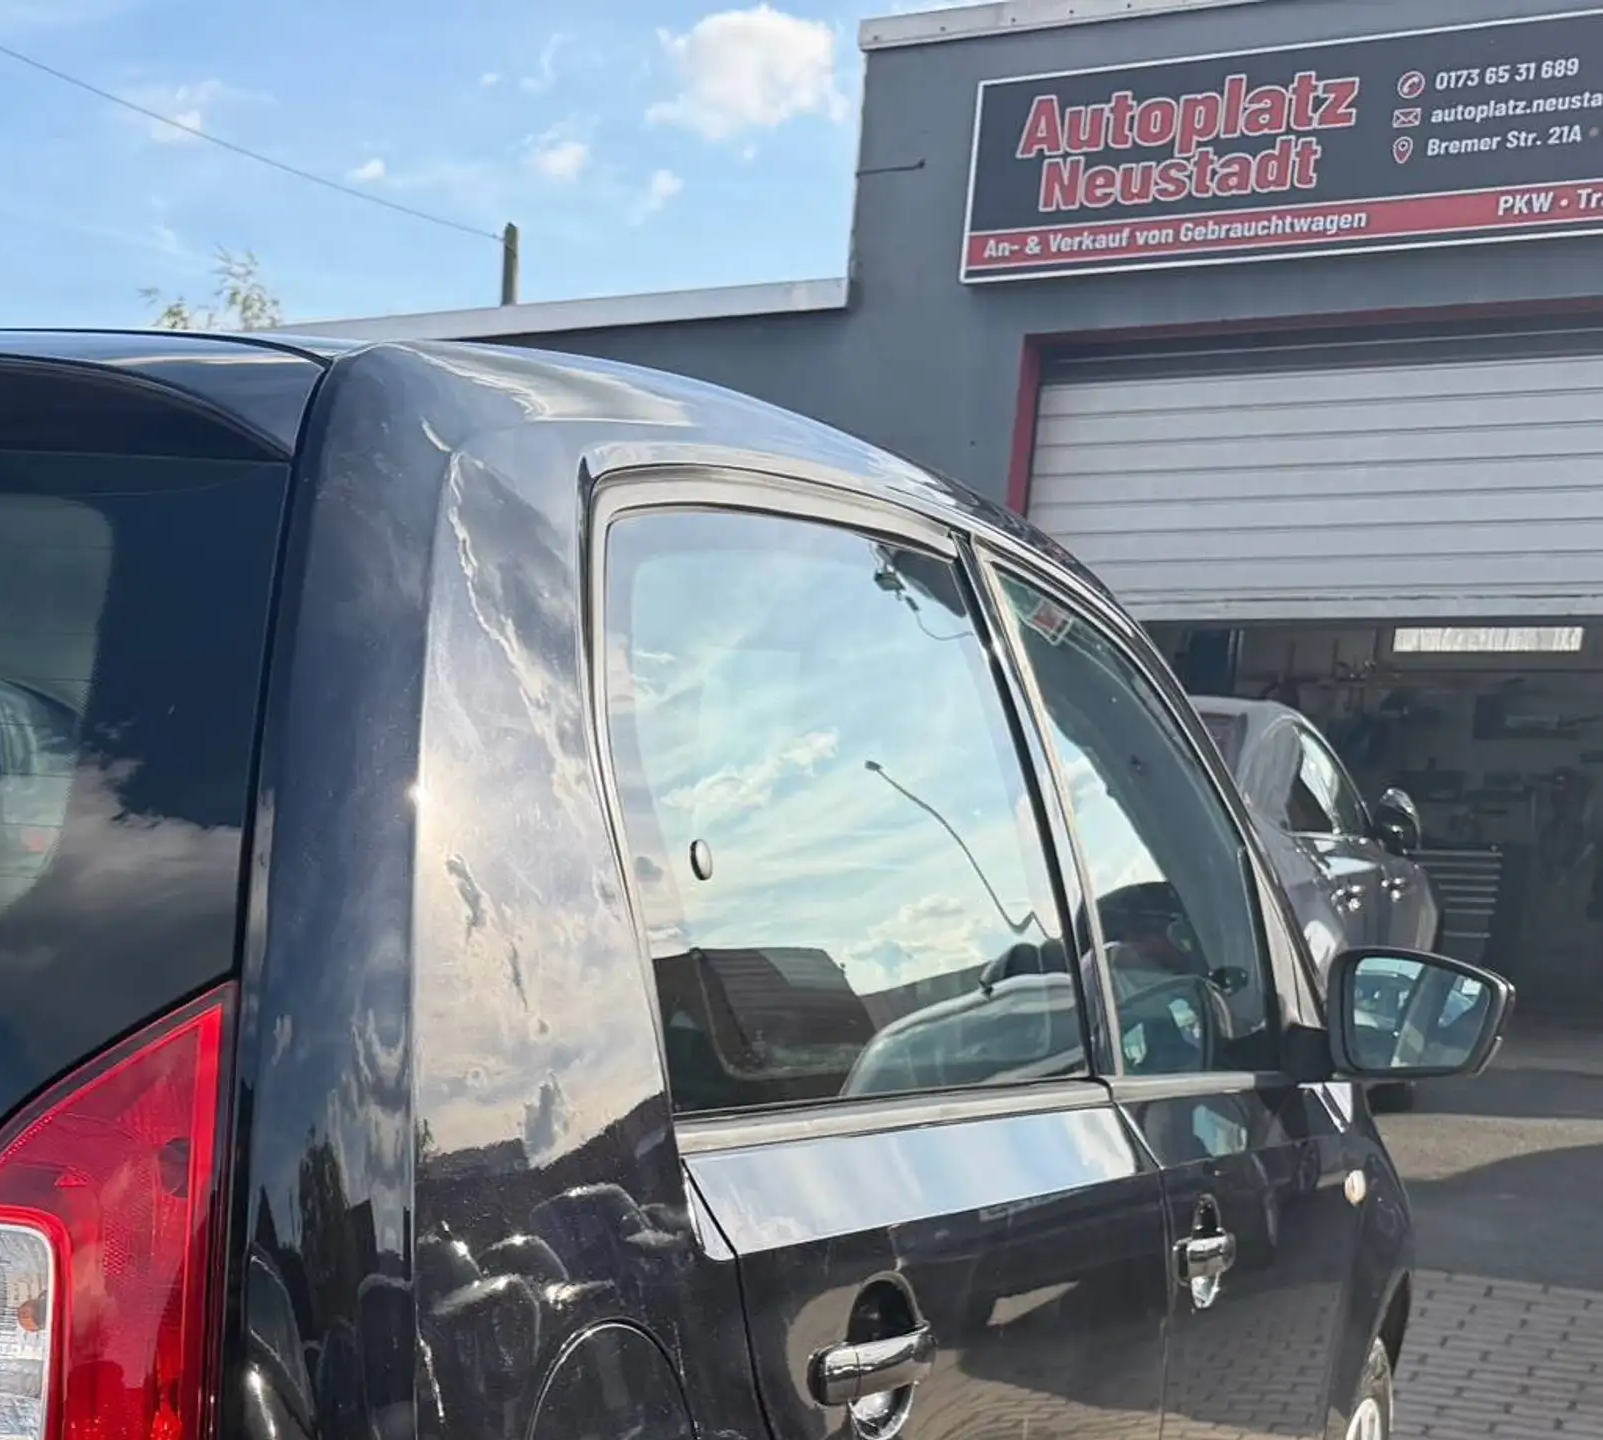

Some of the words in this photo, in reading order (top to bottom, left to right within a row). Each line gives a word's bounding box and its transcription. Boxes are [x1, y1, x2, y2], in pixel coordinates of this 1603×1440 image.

[1435, 69, 1480, 90] 0173
[1485, 65, 1510, 84] 65
[1515, 62, 1536, 81] 31
[1541, 57, 1579, 78] 689
[1016, 71, 1360, 158] Autoplatz
[1427, 136, 1501, 156] Bremer
[1506, 131, 1542, 149] Str.
[1547, 124, 1582, 144] 21A
[1039, 136, 1321, 212] Neustadt
[1498, 191, 1554, 216] PKW
[984, 239, 1020, 259] An-
[1025, 236, 1041, 255] &
[1048, 226, 1130, 253] Verkauf
[1136, 228, 1174, 246] von
[1179, 211, 1368, 243] Gebrauchtwagen
